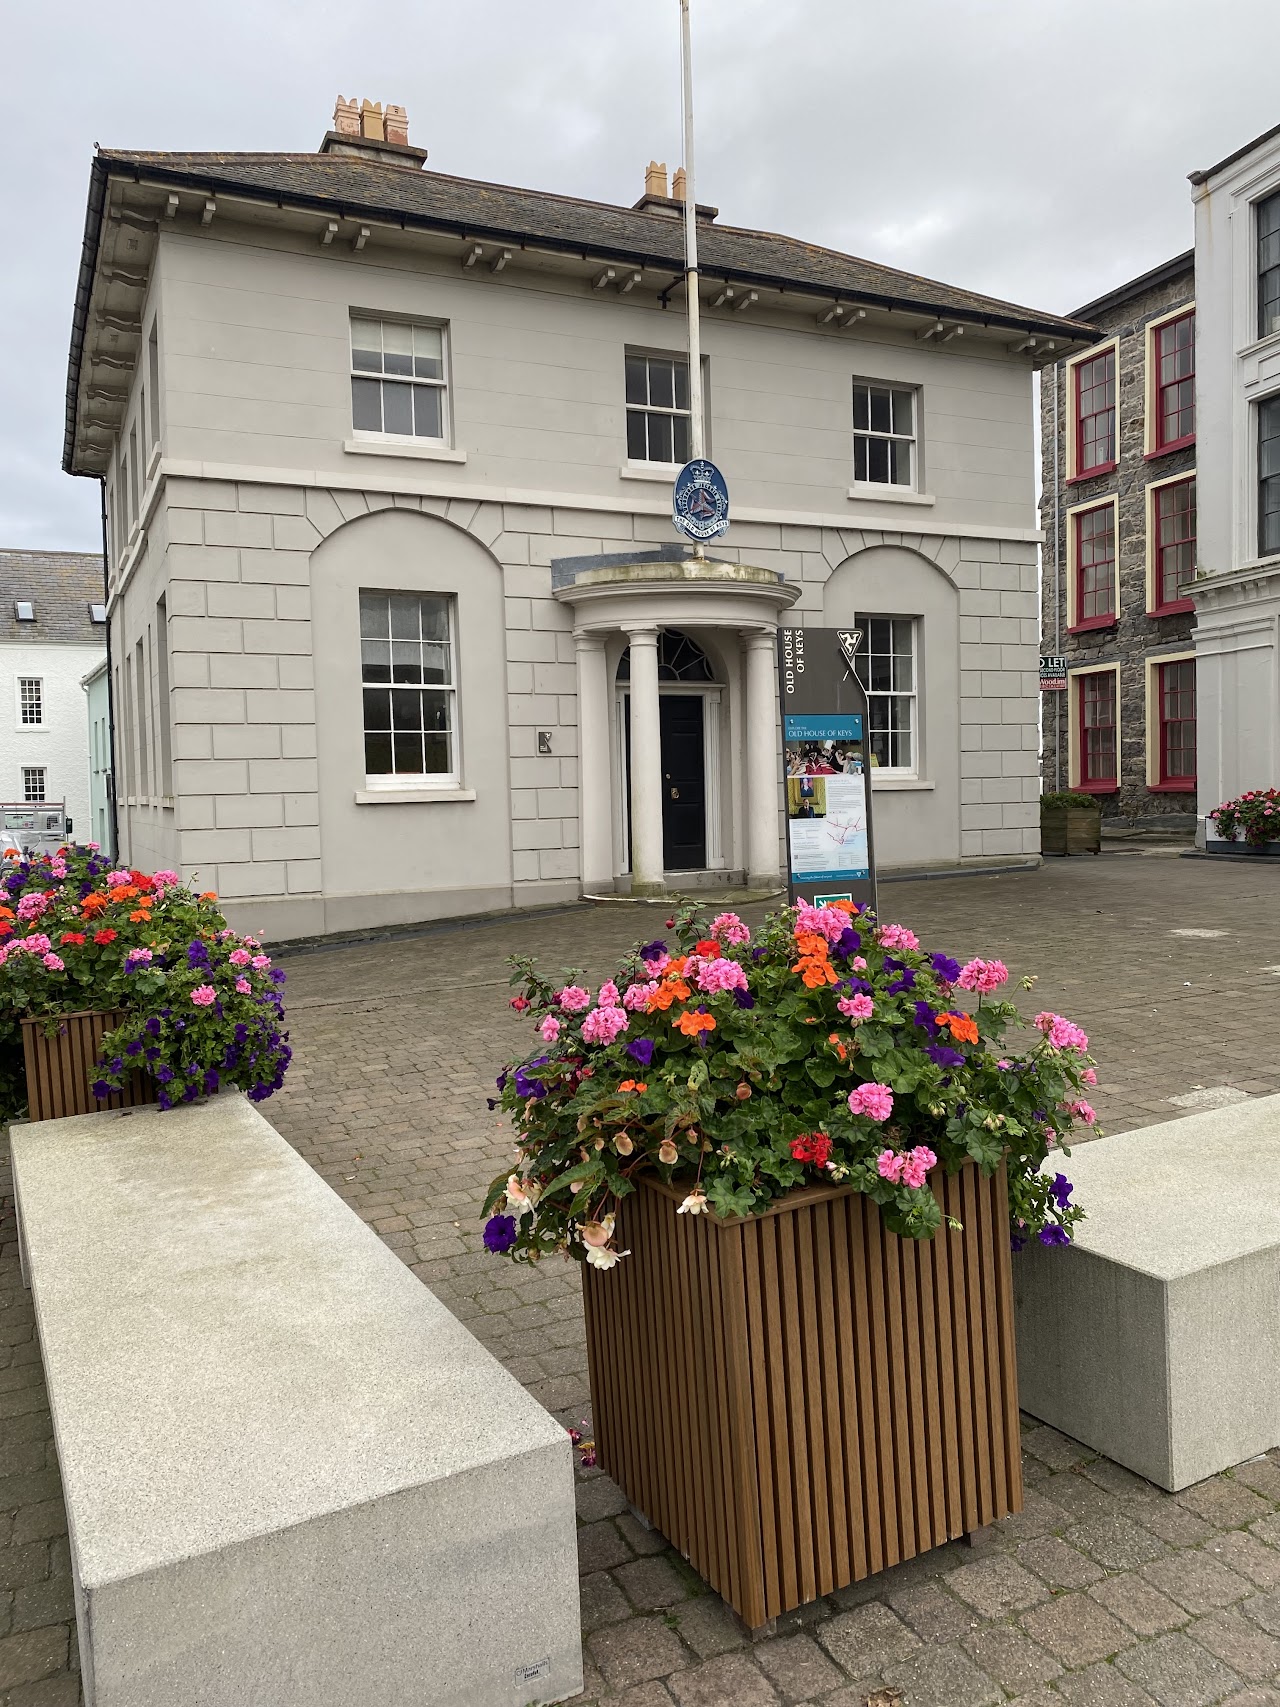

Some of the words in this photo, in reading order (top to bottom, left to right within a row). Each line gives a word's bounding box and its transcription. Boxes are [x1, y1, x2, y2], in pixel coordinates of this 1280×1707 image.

[686, 522, 695, 531] OLD
[784, 629, 794, 667] HOUSE
[795, 629, 804, 655] KEYS
[796, 657, 805, 673] OF
[1048, 658, 1065, 667] LET
[786, 671, 795, 694] OLD
[827, 729, 836, 737] OF
[837, 729, 853, 737] KEYS
